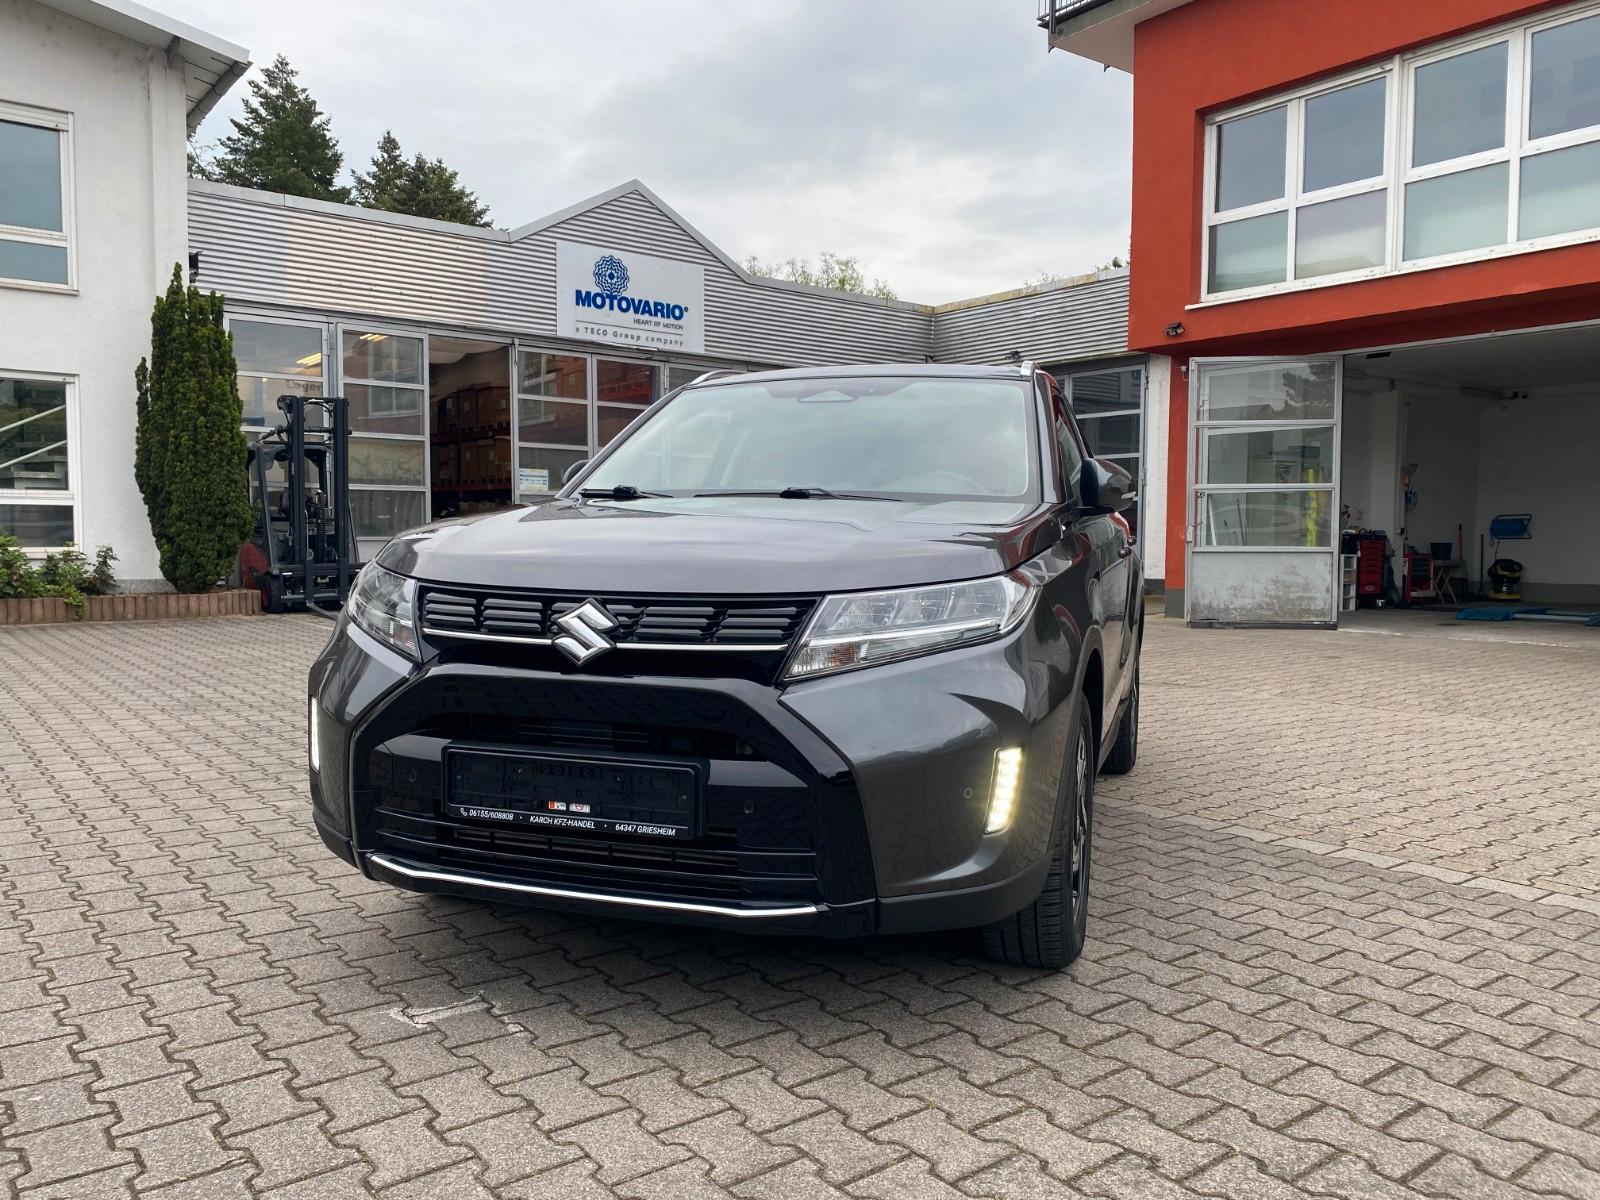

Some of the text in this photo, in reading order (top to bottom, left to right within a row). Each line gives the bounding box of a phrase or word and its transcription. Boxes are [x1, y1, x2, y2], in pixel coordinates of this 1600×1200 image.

[575, 289, 685, 321] MOTOVARIO
[633, 318, 652, 327] HEART
[662, 322, 684, 331] MOTION
[584, 327, 608, 336] TECO
[612, 330, 641, 341] Group
[645, 335, 684, 347] company
[469, 809, 676, 837] 06155/608808 KARCH KFZ-HANDEL 64347 GRIESHEIM
